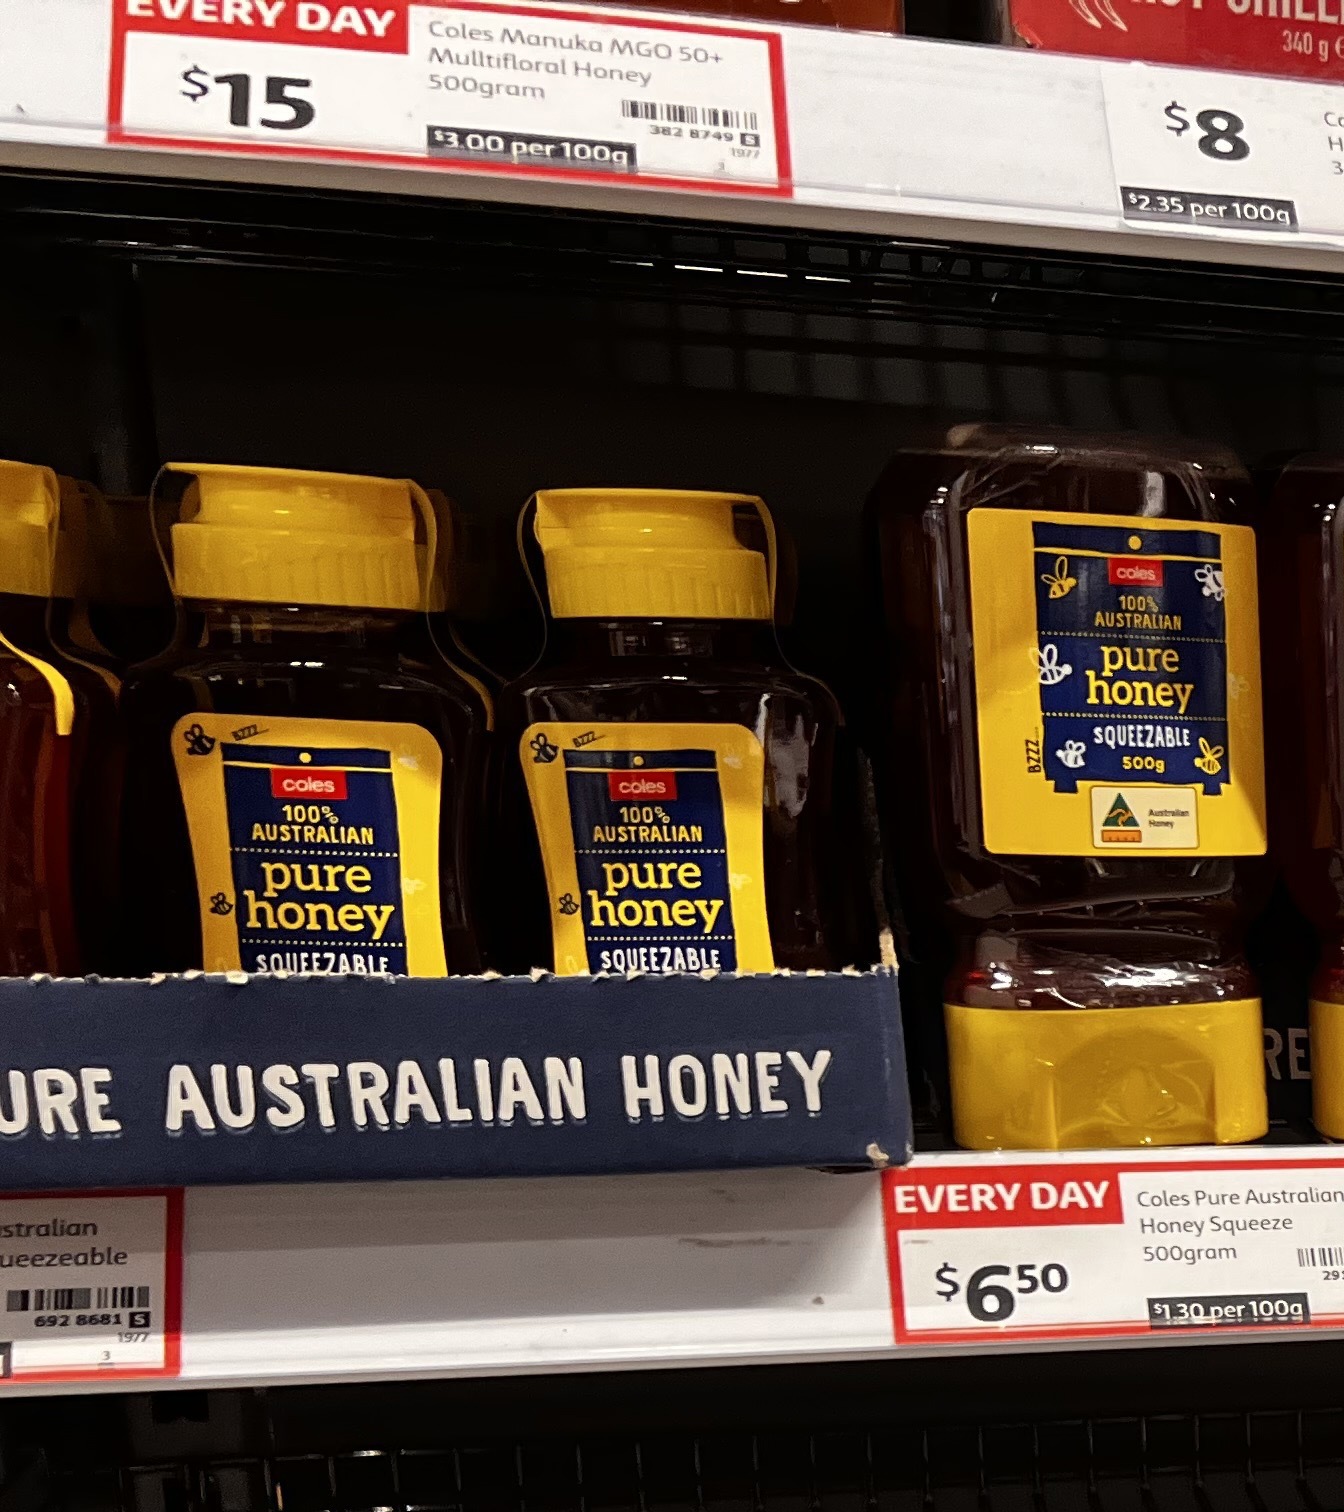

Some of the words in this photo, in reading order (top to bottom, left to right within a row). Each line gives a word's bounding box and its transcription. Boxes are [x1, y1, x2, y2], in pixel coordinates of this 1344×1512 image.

[296, 1, 396, 37] DAY
[428, 20, 494, 42] Coles
[500, 27, 603, 53] Manuka
[610, 39, 672, 59] MGO
[679, 46, 724, 64] 50+
[1282, 29, 1314, 55] 340
[428, 74, 546, 99] 500gram
[574, 56, 652, 87] Honey
[181, 64, 316, 130] $15
[434, 130, 504, 152] $3.00
[511, 141, 555, 164] per
[561, 142, 629, 164] 100g
[1163, 101, 1251, 162] $8
[1129, 191, 1183, 215] $2.35
[1190, 202, 1228, 228] per
[1231, 202, 1291, 226] 100g
[165, 1058, 587, 1134] AUSTRALIAN
[619, 1049, 835, 1123] HONEY
[894, 1183, 1022, 1214] EVERY
[1031, 1181, 1111, 1211] DAY
[1136, 1190, 1190, 1209] Coles
[1195, 1190, 1241, 1209] Pure
[1139, 1217, 1205, 1238] Honey
[1210, 1215, 1294, 1237] Squeeze
[1144, 1244, 1238, 1267] 500gram
